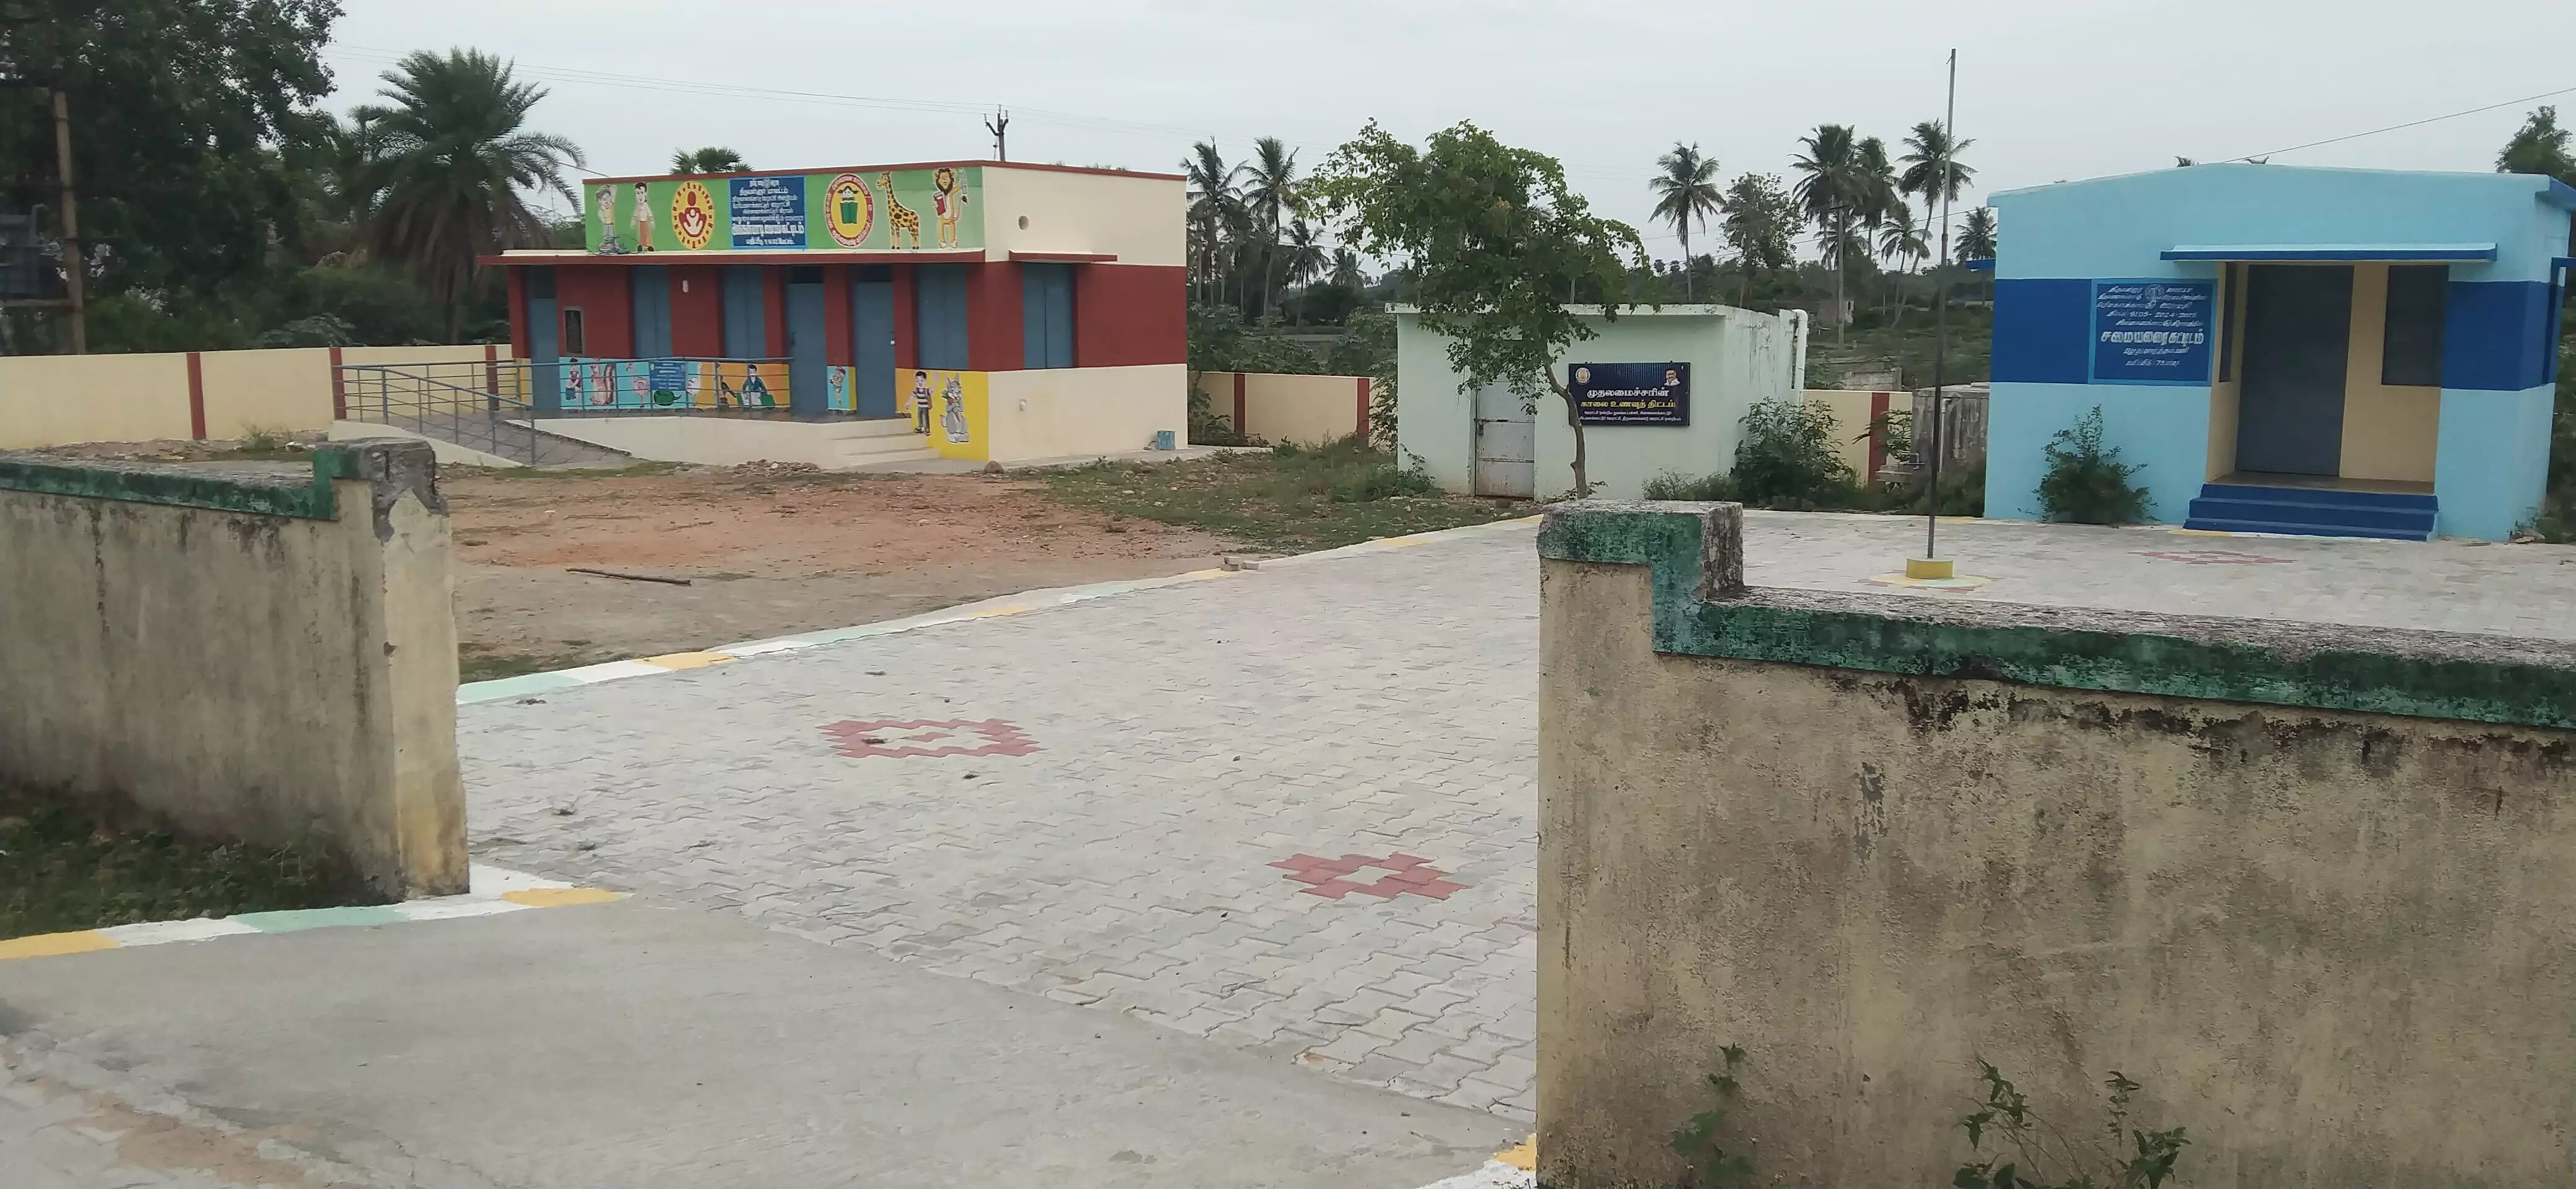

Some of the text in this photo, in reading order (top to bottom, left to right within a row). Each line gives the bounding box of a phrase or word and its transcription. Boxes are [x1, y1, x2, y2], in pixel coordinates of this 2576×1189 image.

[1586, 386, 1670, 399] முதலமைச்சரின்
[1610, 399, 1646, 409] உணவுத்
[1647, 399, 1676, 409] திட்டம்
